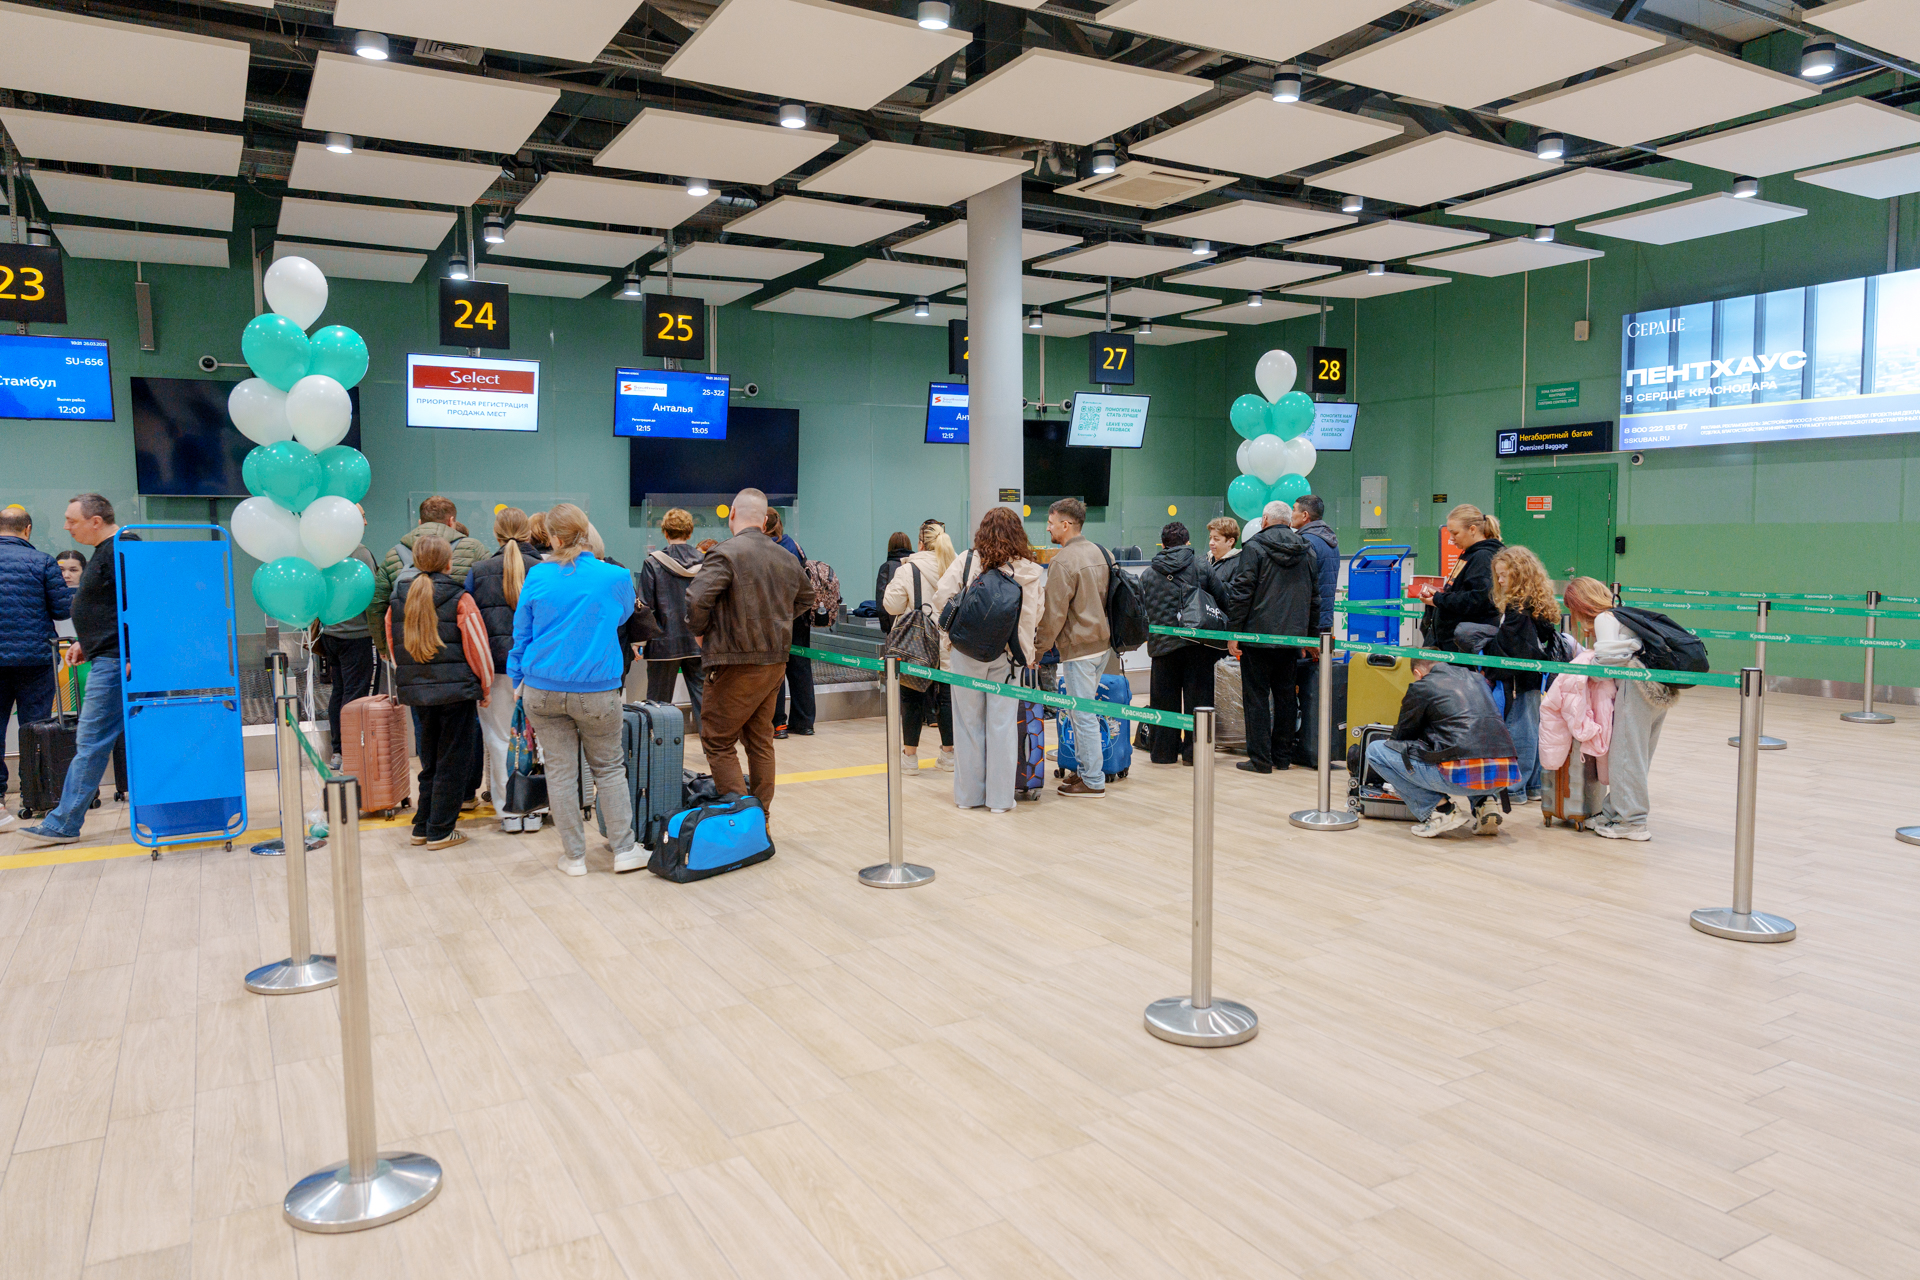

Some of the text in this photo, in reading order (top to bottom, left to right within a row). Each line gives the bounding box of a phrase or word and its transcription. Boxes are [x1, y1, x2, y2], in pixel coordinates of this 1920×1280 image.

[0, 265, 45, 301] 23
[454, 299, 496, 330] 24
[658, 313, 693, 341] 25
[1627, 318, 1686, 338] СЕРДЦЕ
[66, 357, 104, 366] SU-656
[1103, 347, 1127, 369] 27
[1319, 359, 1340, 381] 28
[1626, 350, 1807, 386] ПЕНТХАУС
[0, 376, 56, 389] Стамбул
[448, 370, 500, 384] Select
[1625, 381, 1778, 403] В СЕРДЦЕ КРАСНОДАРА
[652, 403, 693, 413] Анталья
[1520, 430, 1593, 441] Негабаритный багаж
[1419, 651, 1448, 659] Краснодар
[1501, 659, 1534, 668] Краснодар
[908, 665, 928, 676] Краснодар
[1604, 668, 1642, 677] Краснодар
[972, 680, 995, 691] Краснодар
[1043, 694, 1071, 705] Краснодар
[1122, 707, 1154, 720] Краснодар
